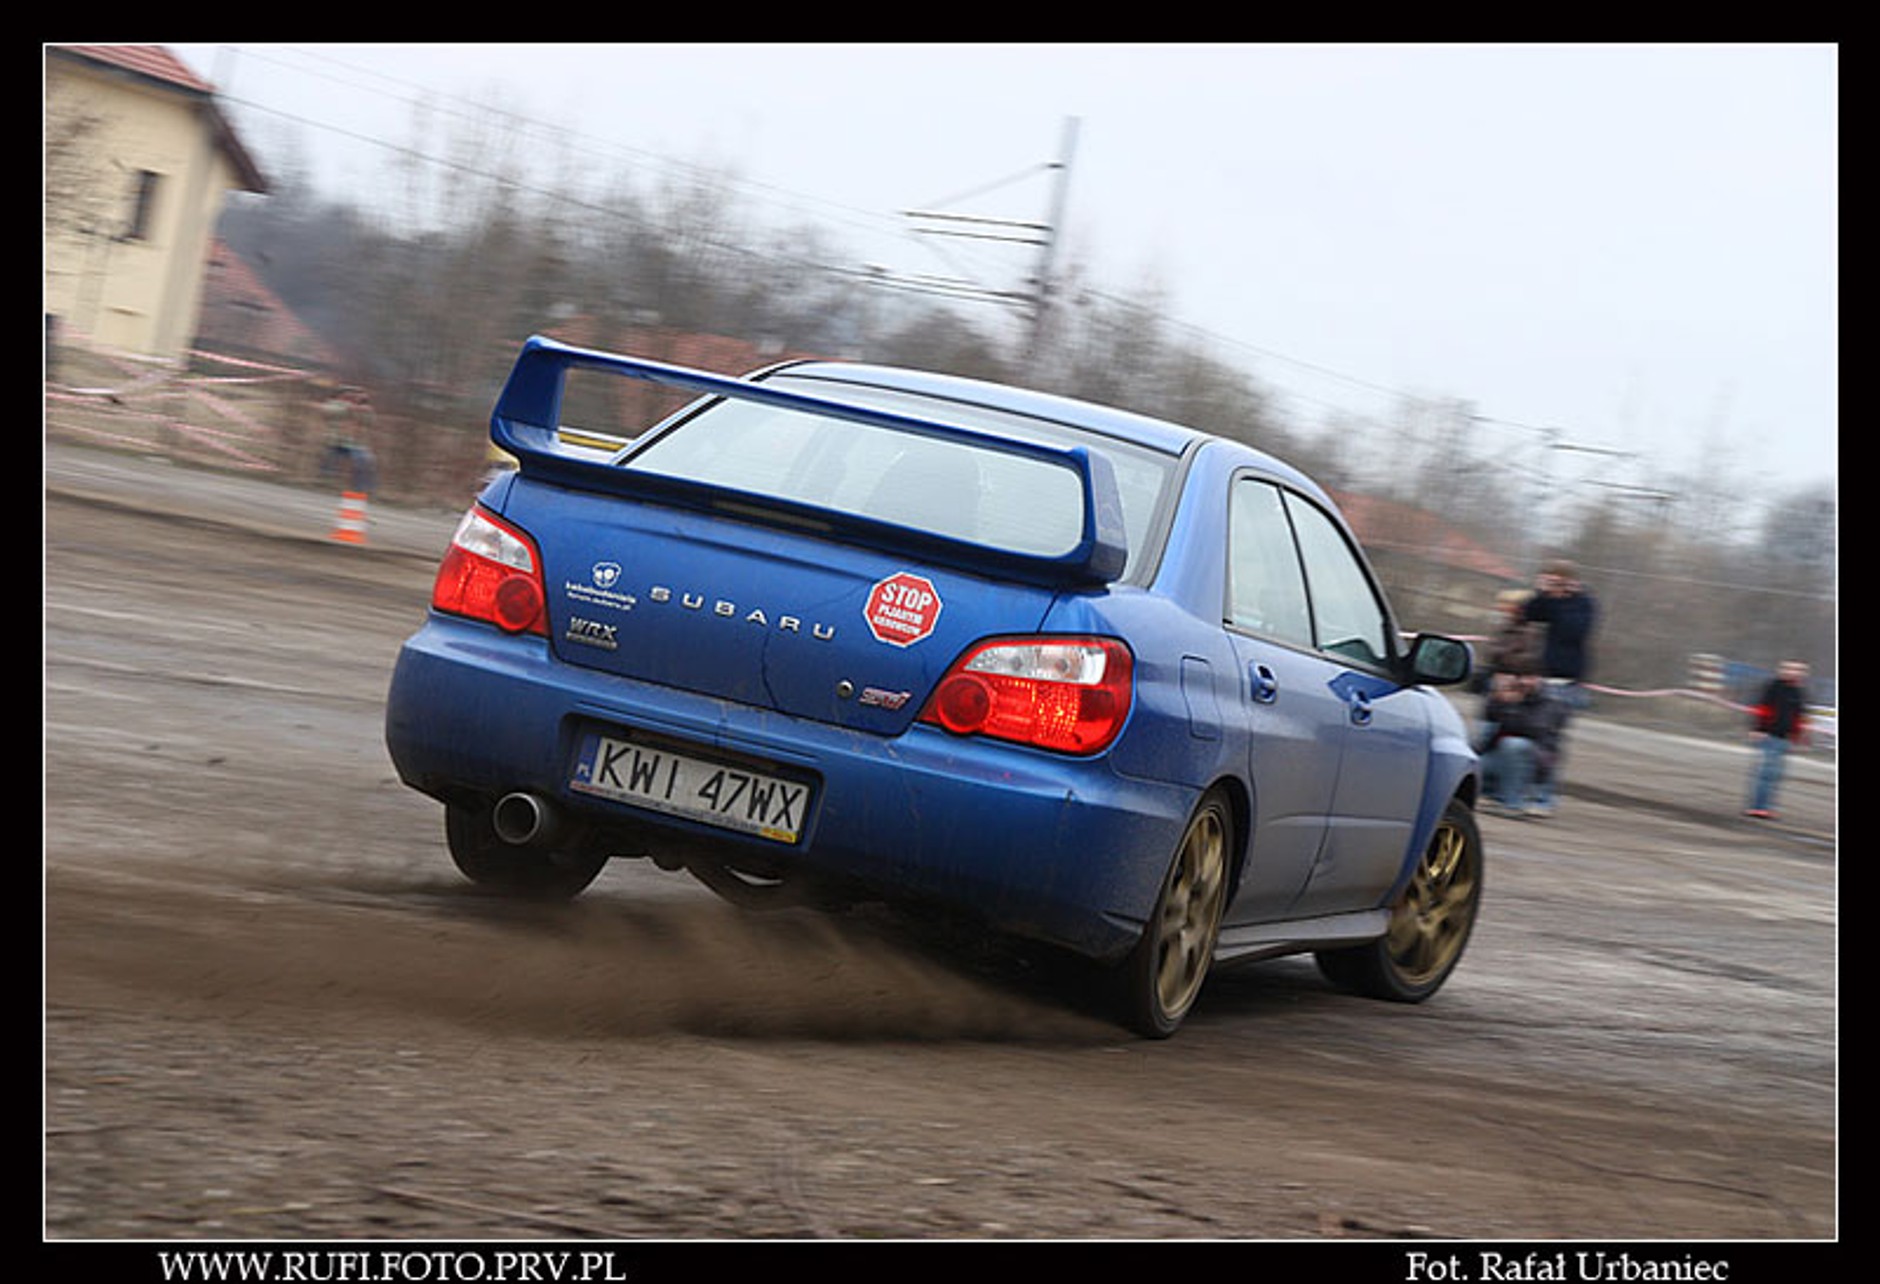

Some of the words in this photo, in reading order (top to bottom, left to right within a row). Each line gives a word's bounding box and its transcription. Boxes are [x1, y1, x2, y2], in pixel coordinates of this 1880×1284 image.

[650, 586, 834, 641] SUBARU
[880, 583, 933, 611] STOP
[570, 617, 618, 641] WRX
[598, 743, 679, 800] KWI
[697, 769, 802, 829] 47WX
